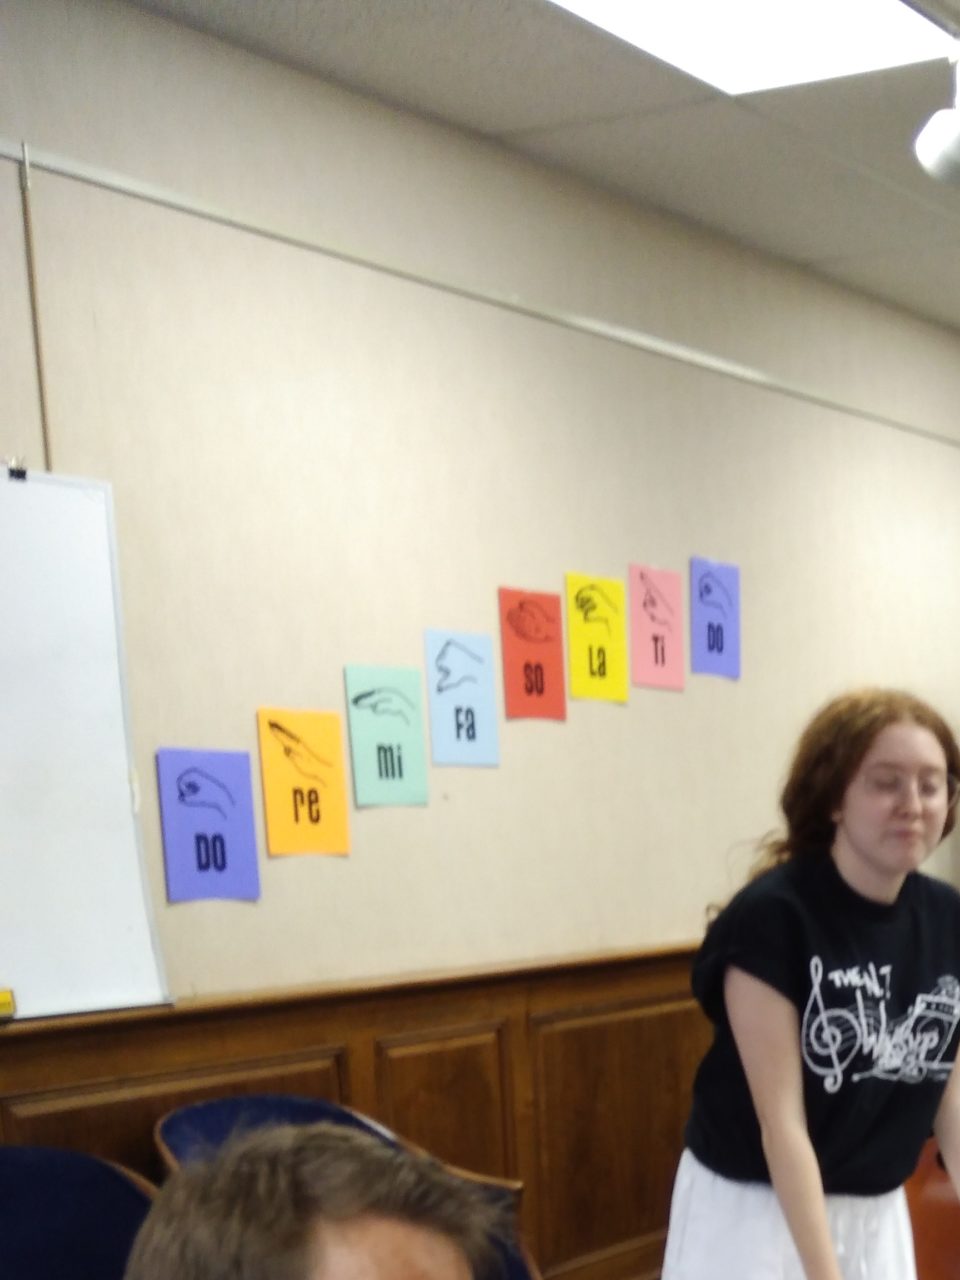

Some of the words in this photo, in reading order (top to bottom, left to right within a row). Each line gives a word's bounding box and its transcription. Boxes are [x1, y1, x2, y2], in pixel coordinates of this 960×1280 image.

[707, 621, 724, 653] DO
[523, 662, 545, 696] SO
[376, 744, 404, 779] mi
[292, 788, 321, 824] re
[194, 833, 228, 872] DO
